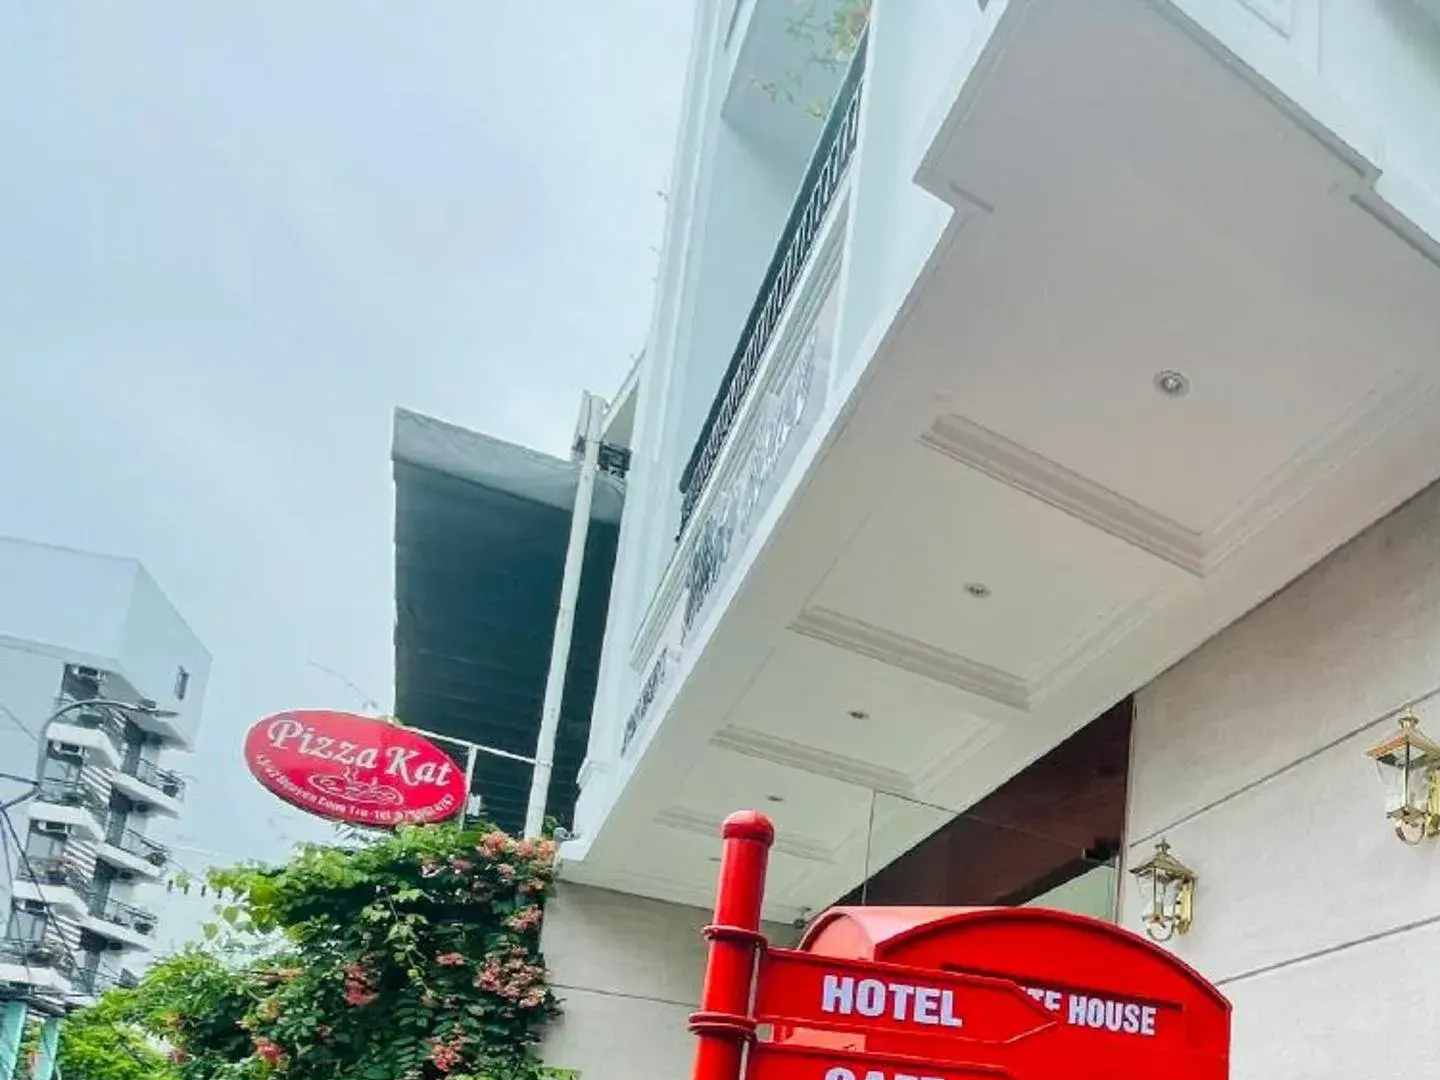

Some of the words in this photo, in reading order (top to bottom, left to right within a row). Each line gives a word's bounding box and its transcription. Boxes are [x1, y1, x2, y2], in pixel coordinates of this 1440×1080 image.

[266, 719, 379, 769] Pizza
[384, 745, 453, 788] Kat
[821, 974, 963, 1028] HOTEL
[1067, 993, 1158, 1036] HOUSE
